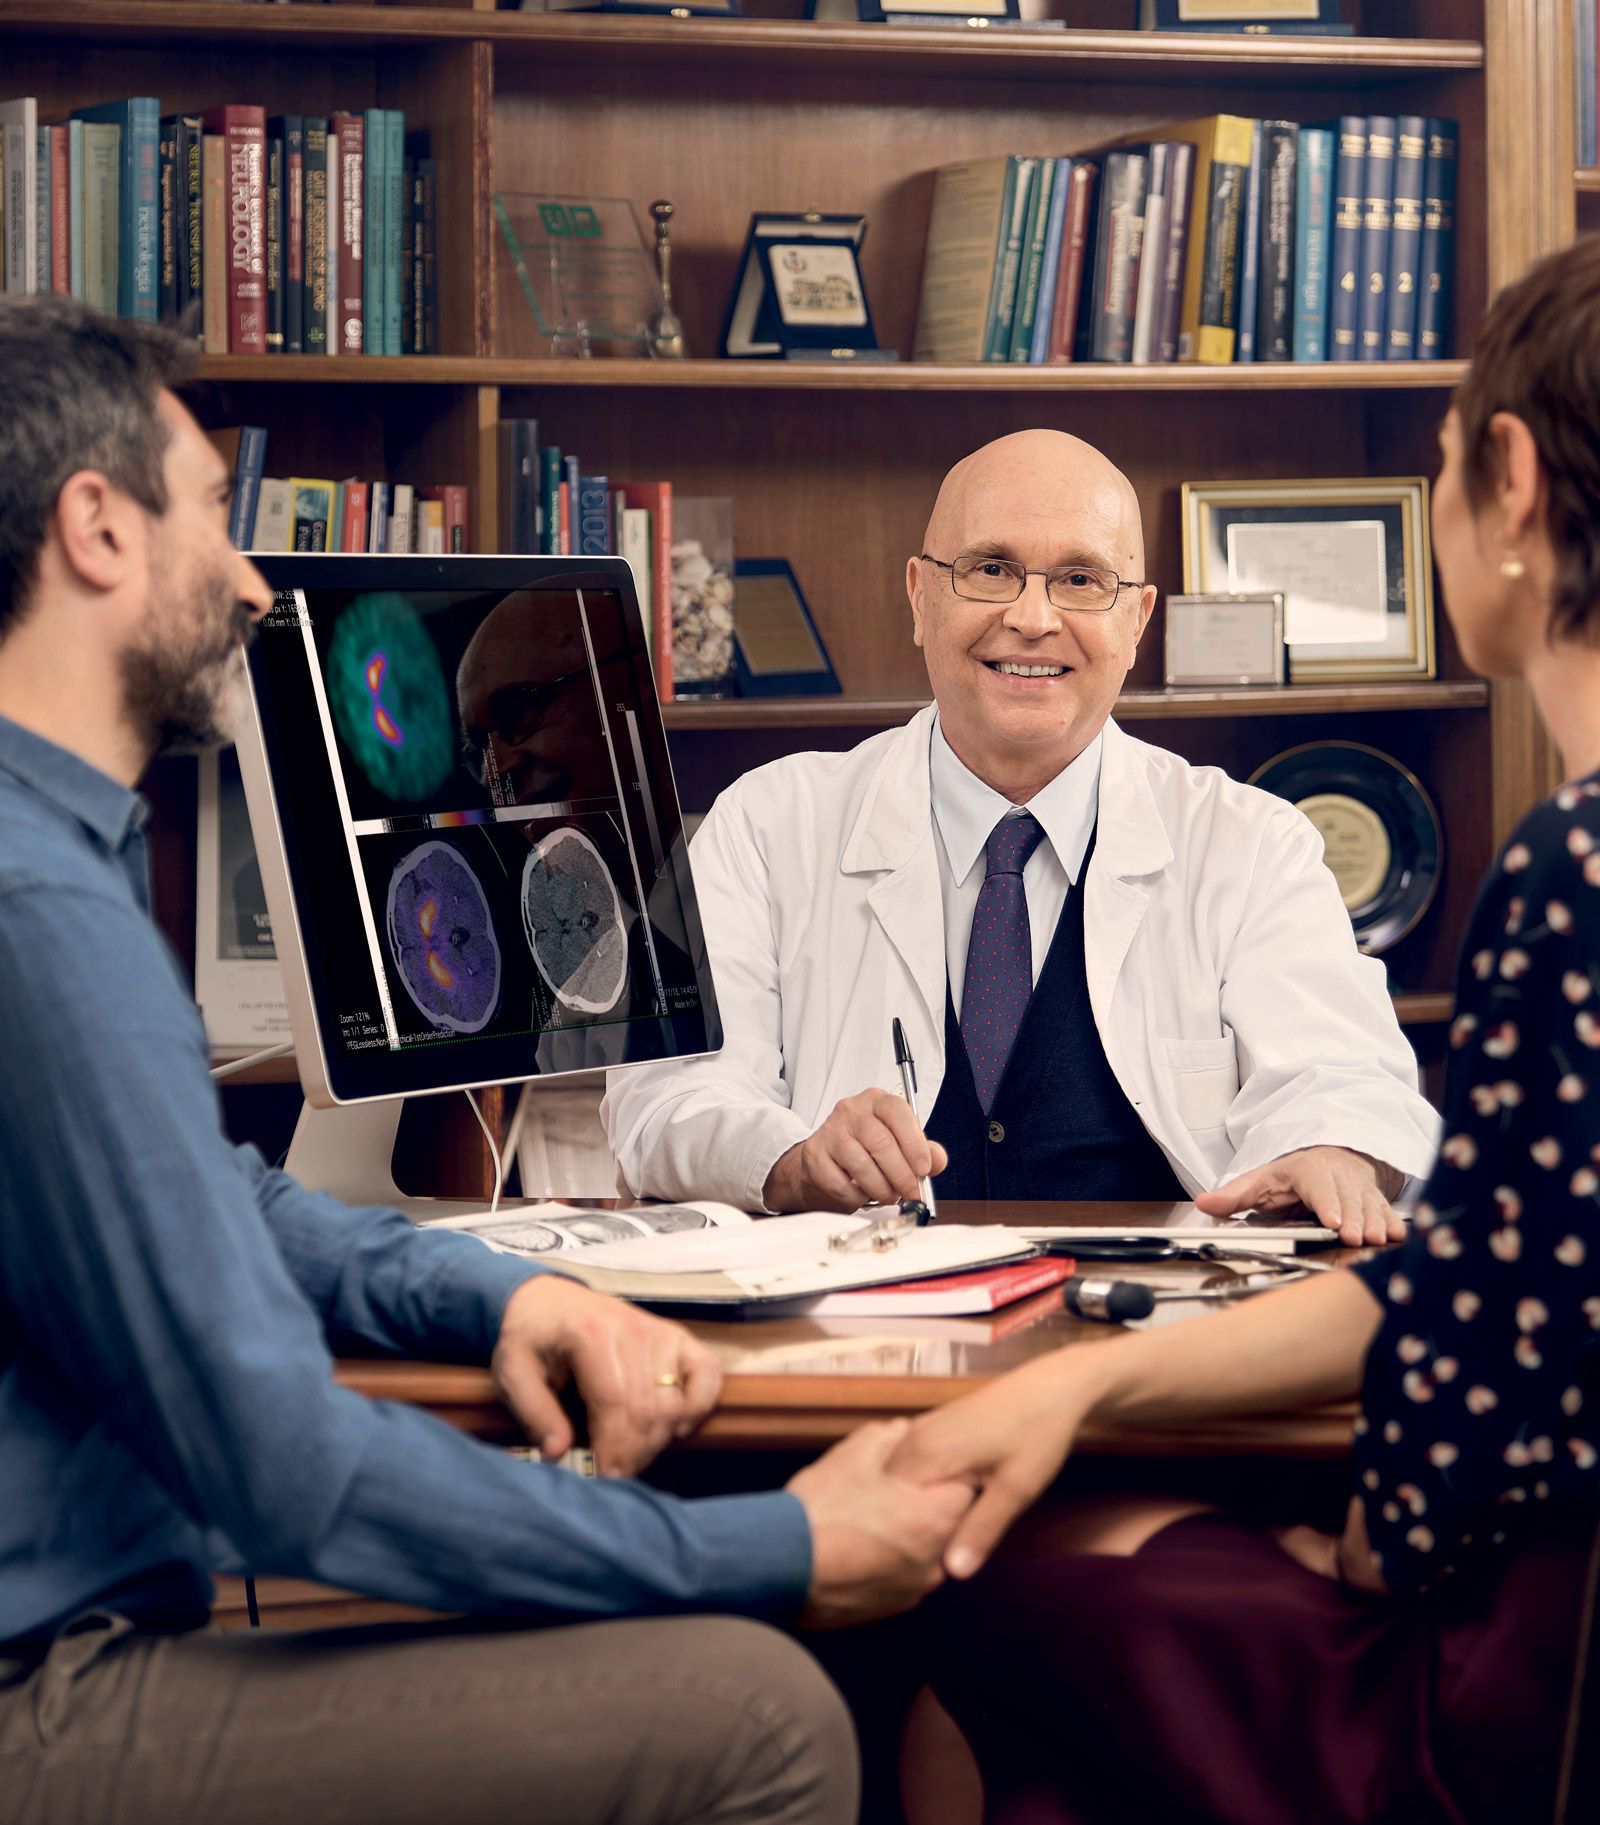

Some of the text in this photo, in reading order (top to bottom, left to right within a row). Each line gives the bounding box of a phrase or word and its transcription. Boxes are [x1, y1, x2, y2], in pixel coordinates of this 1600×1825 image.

[189, 144, 200, 289] NEURAL TRANSPLANTS
[231, 143, 250, 273] NEUROLOGY
[134, 206, 154, 292] neurologia
[1340, 271, 1355, 292] 4
[1370, 272, 1385, 294] 3
[1397, 271, 1413, 294] 2
[582, 490, 607, 553] 2013
[616, 703, 626, 712] 255
[340, 1012, 371, 1023] Zoom: 121%
[350, 1026, 360, 1035] 1/1
[362, 1025, 378, 1034] Series:
